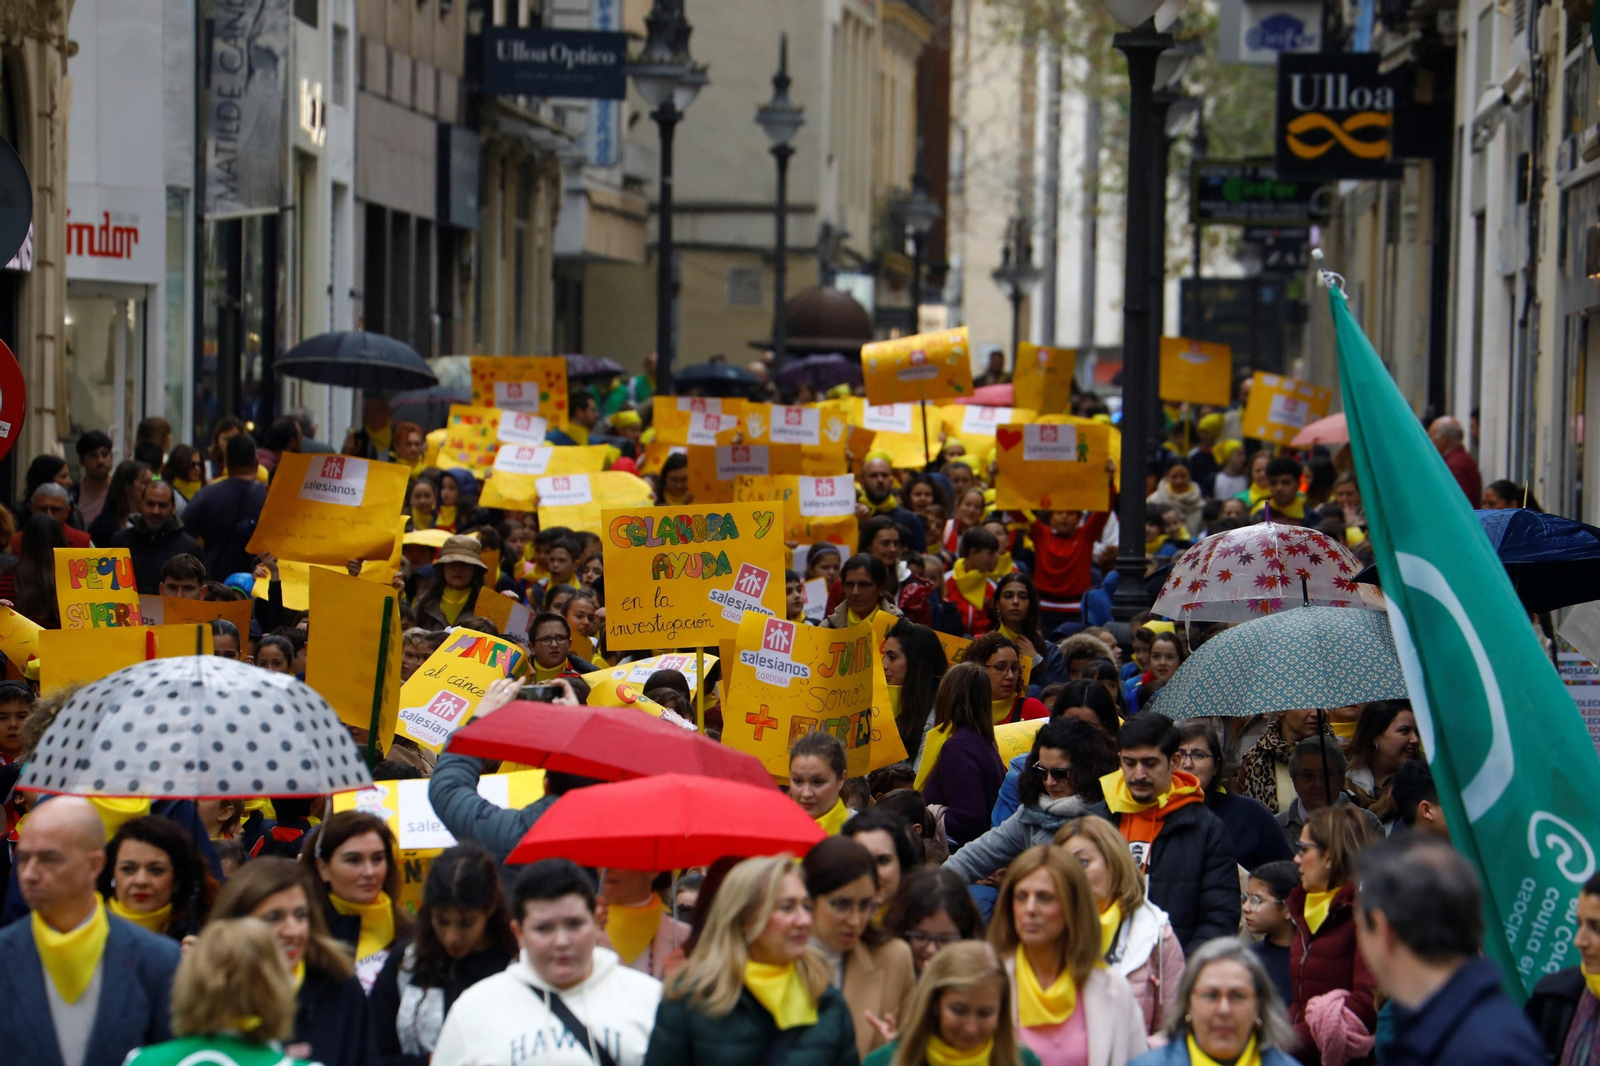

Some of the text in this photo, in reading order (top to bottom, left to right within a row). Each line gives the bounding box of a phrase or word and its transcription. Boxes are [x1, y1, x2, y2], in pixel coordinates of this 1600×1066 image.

[496, 40, 548, 64] Ulloa
[1291, 73, 1394, 111] Ulloa
[303, 481, 357, 496] salesianos
[802, 499, 850, 508] salesianos
[609, 513, 740, 548] COLABORA
[752, 511, 774, 539] Y
[652, 550, 733, 580] AYUDA
[620, 586, 675, 611] en la
[610, 613, 714, 640] investigación
[424, 664, 448, 678] al
[741, 651, 809, 678] salesianos
[756, 671, 788, 685] CÓRDOBA
[407, 725, 437, 744] CÓRDOBA
